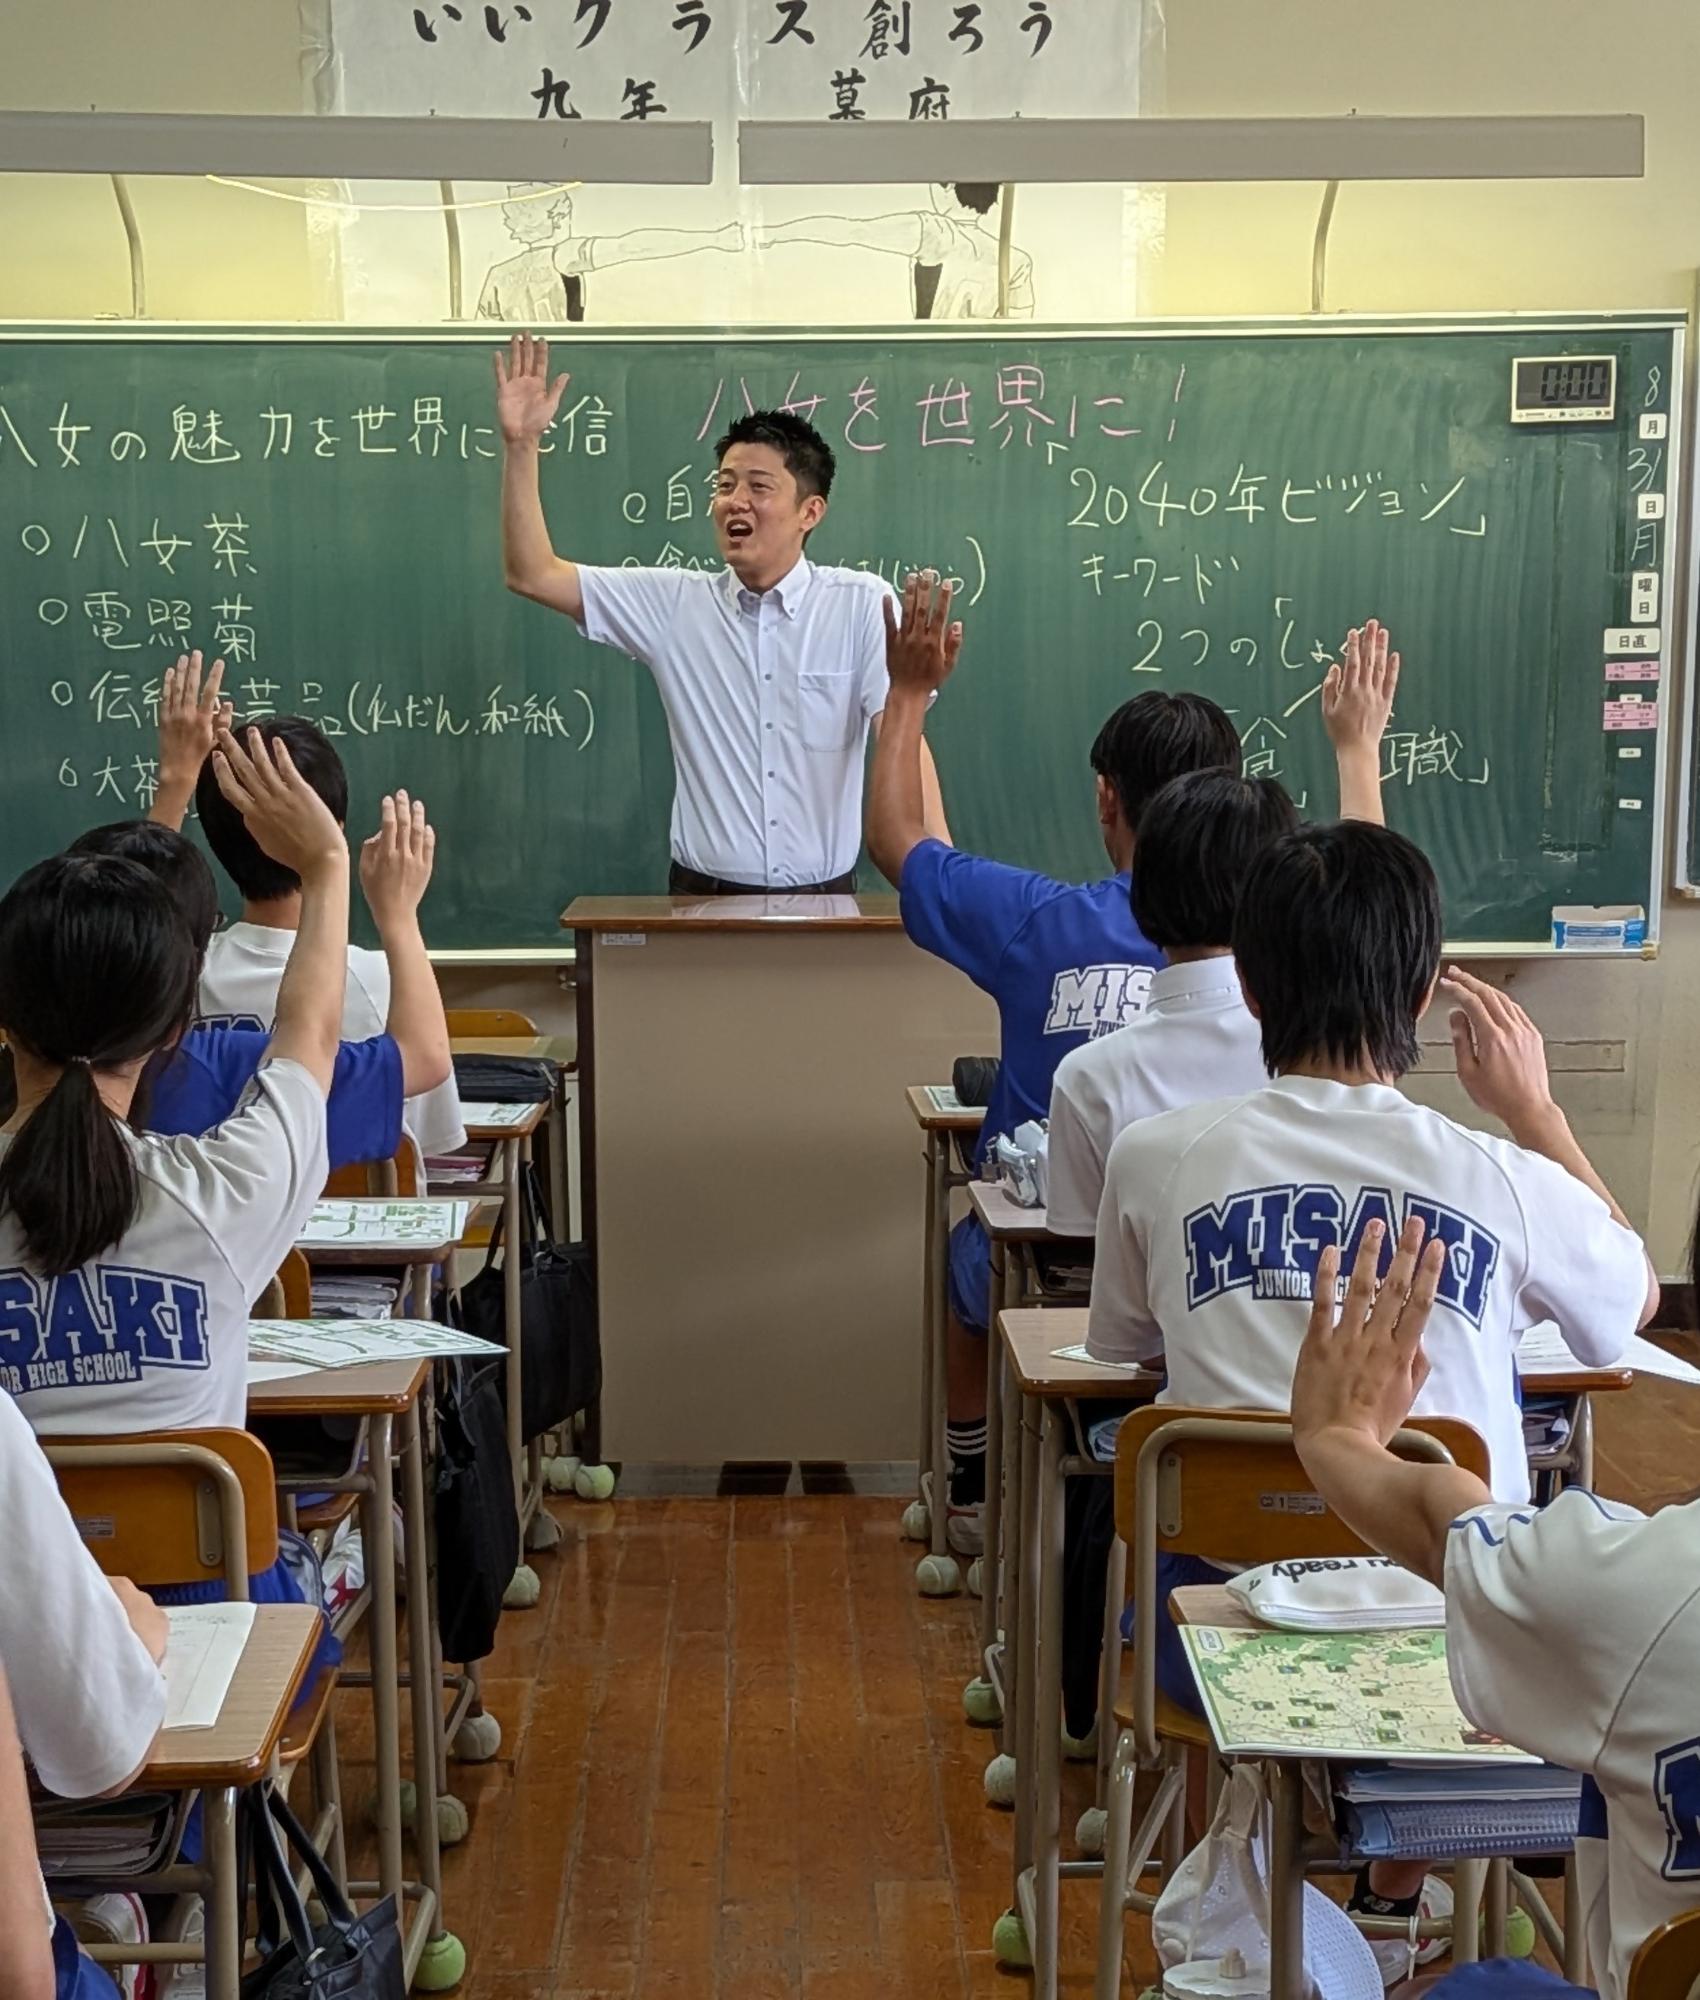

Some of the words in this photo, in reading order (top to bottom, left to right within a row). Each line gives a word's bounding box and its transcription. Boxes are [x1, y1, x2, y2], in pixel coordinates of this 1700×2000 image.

[412, 0, 1056, 58] いいクラス創ろう
[0, 396, 613, 467] 八女の魅力を世界に信
[1646, 421, 1658, 435] 月
[1645, 500, 1656, 514] 日
[1082, 553, 1240, 605] キーワード
[1618, 634, 1648, 650] 日直
[1043, 964, 1156, 1034] MIS
[1183, 1184, 1501, 1332] MISAKI
[1255, 1269, 1312, 1298] JUNIOR
[26, 1360, 69, 1389] HIGH
[72, 1350, 137, 1384] SCHOOL
[1271, 1559, 1359, 1583] ready
